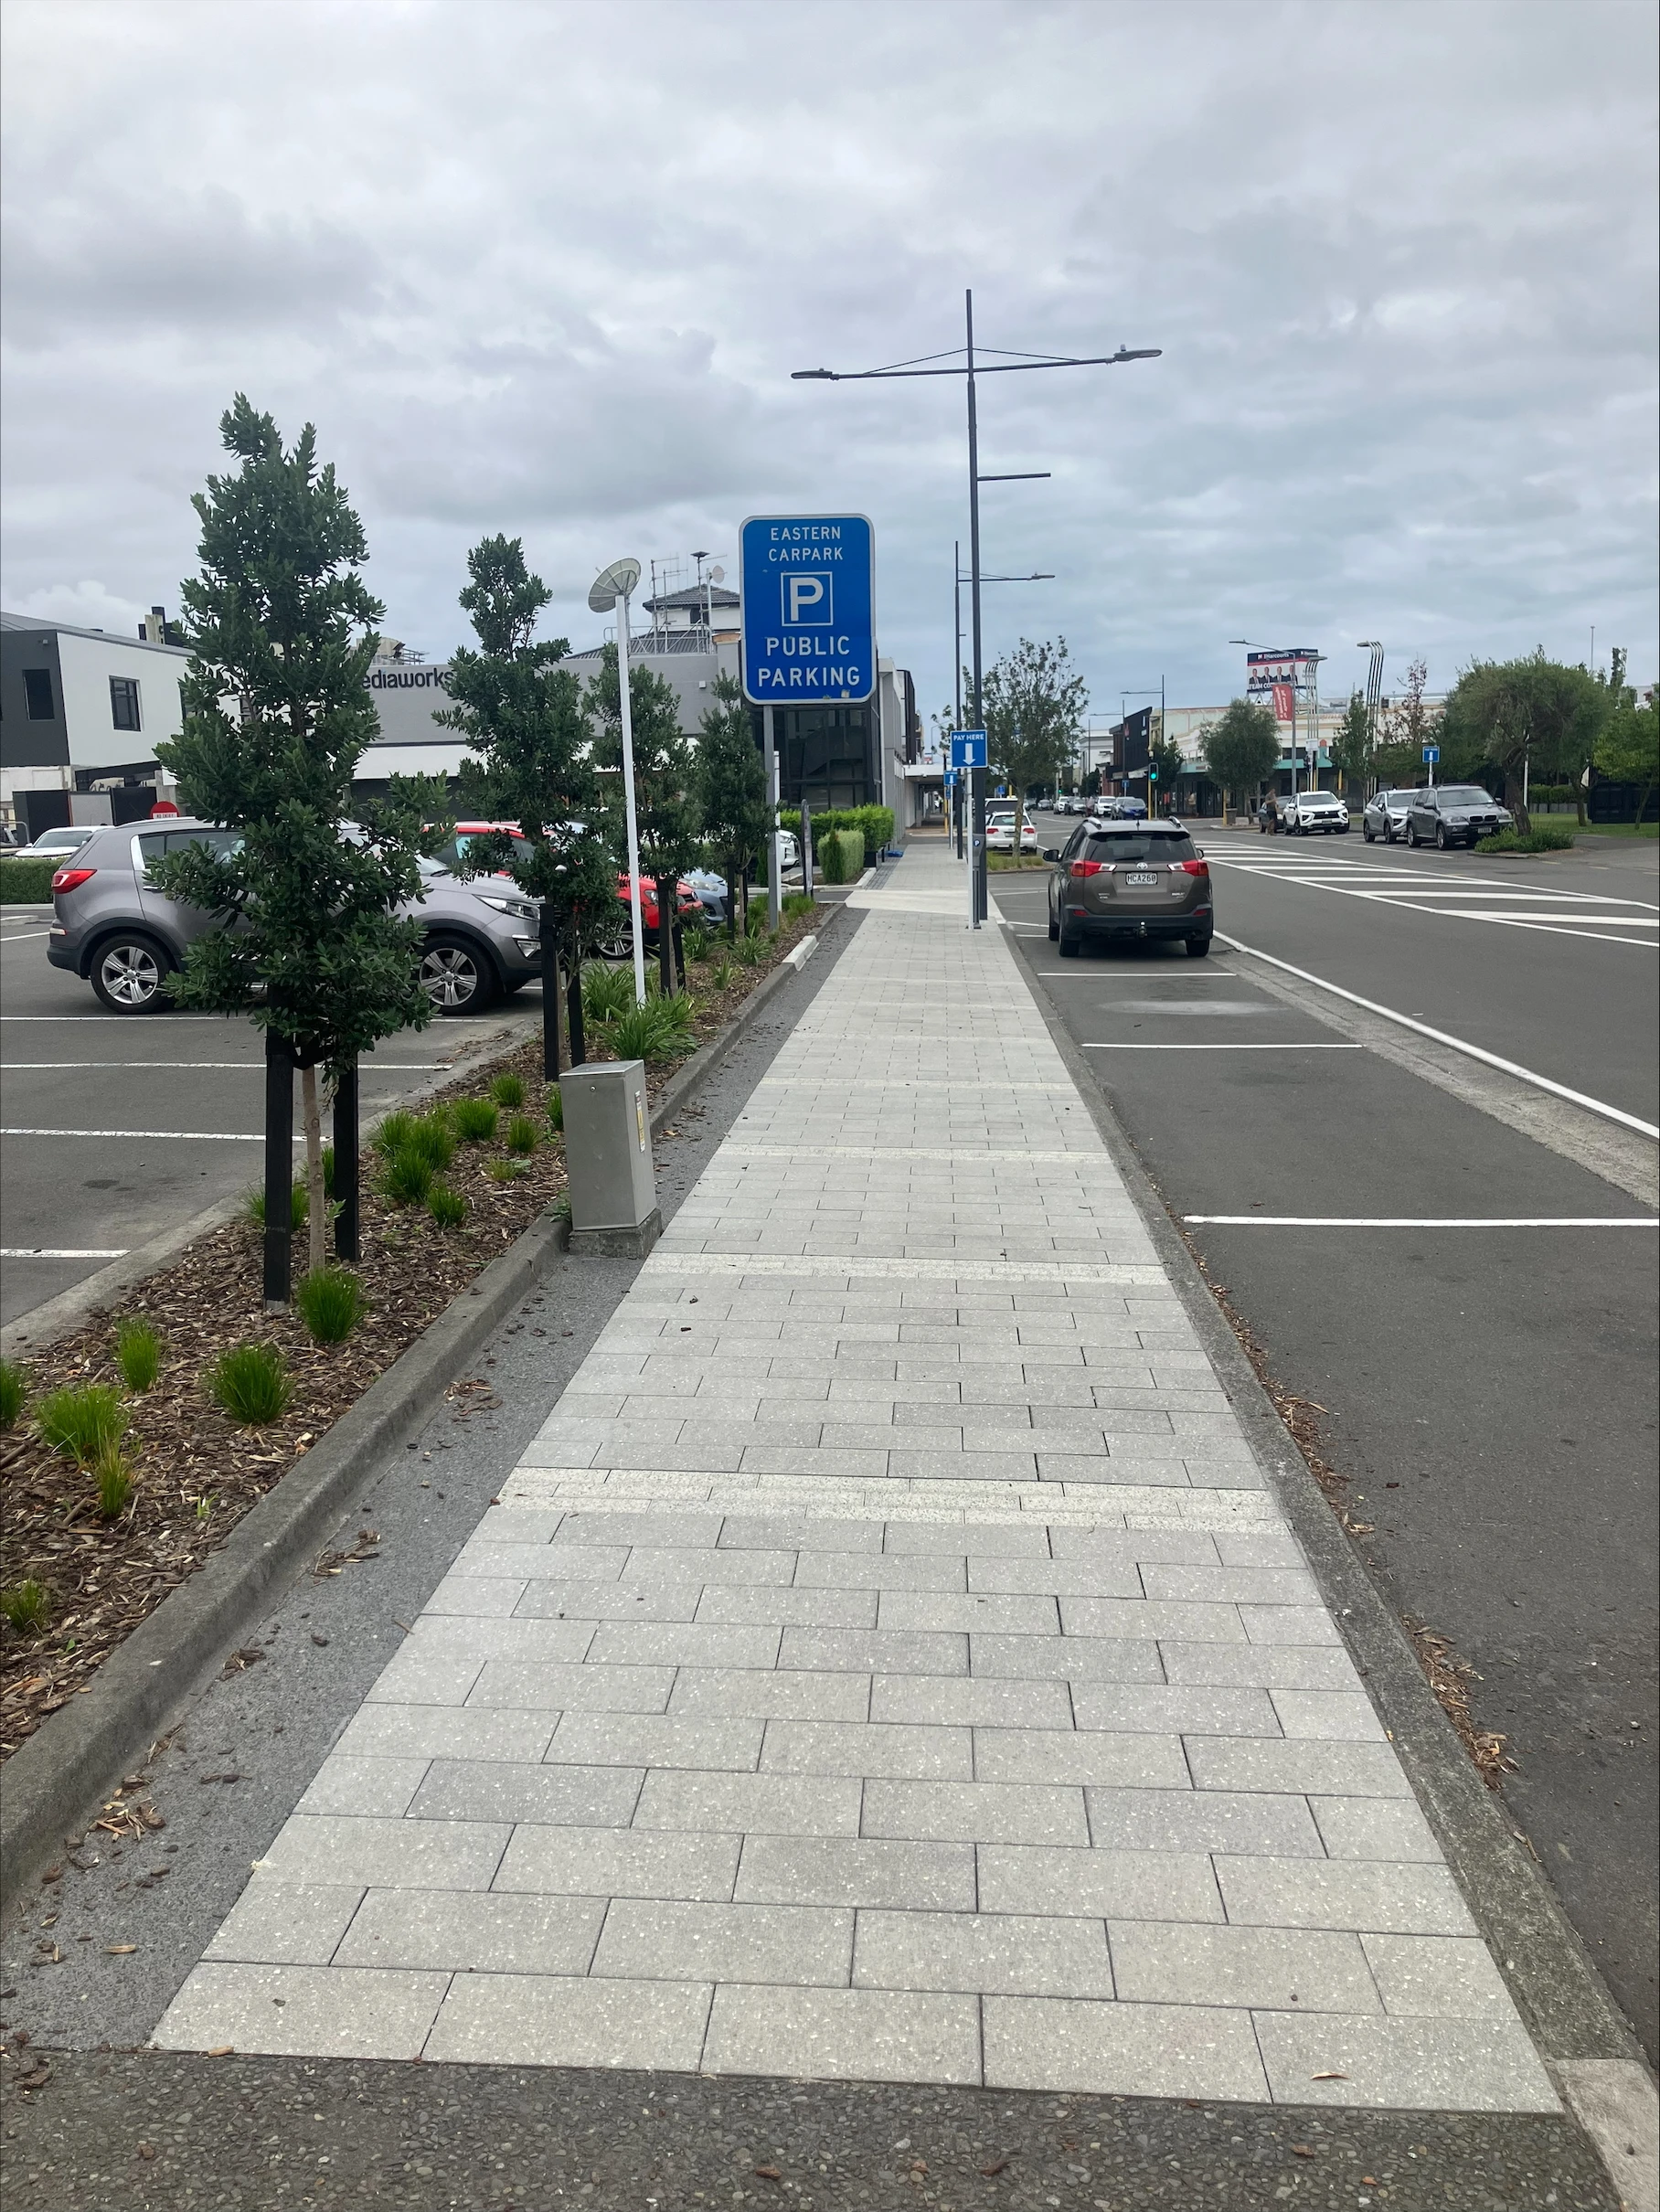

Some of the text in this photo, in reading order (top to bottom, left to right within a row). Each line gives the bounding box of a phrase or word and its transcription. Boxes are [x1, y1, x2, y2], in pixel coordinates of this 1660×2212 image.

[771, 526, 841, 540] EASTERN
[769, 548, 843, 561] CARPARK
[790, 577, 824, 622] P
[766, 636, 849, 656] PUBLIC
[361, 667, 455, 689] ediaworks
[758, 666, 860, 686] PARKING
